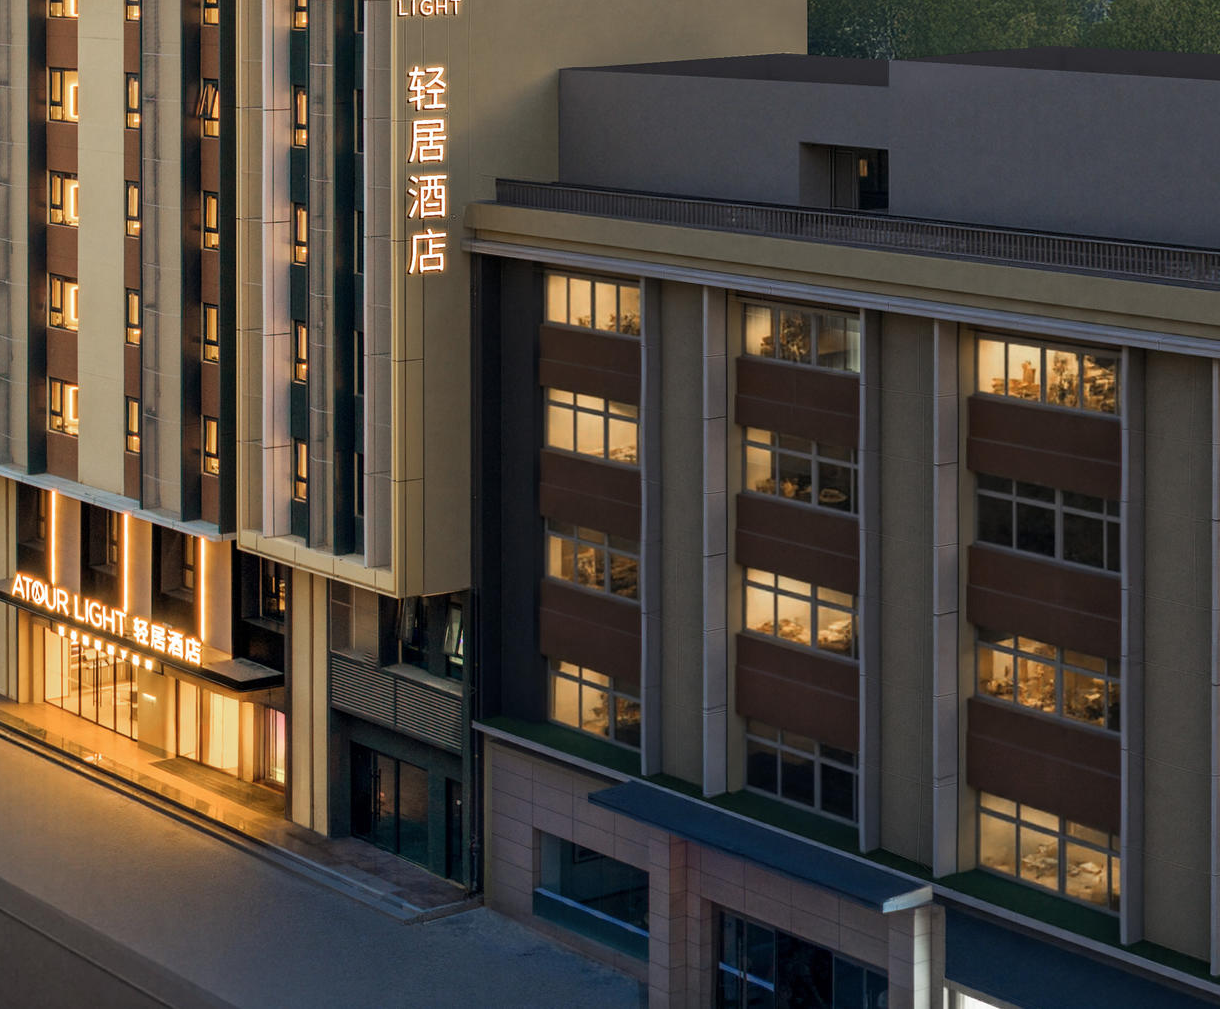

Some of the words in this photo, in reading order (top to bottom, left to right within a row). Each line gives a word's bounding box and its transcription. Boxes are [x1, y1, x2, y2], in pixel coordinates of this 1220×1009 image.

[408, 66, 447, 275] 轻居酒店
[11, 574, 69, 617] ATOUR
[73, 593, 128, 637] LIGHT
[132, 617, 202, 665] 轻居酒店
